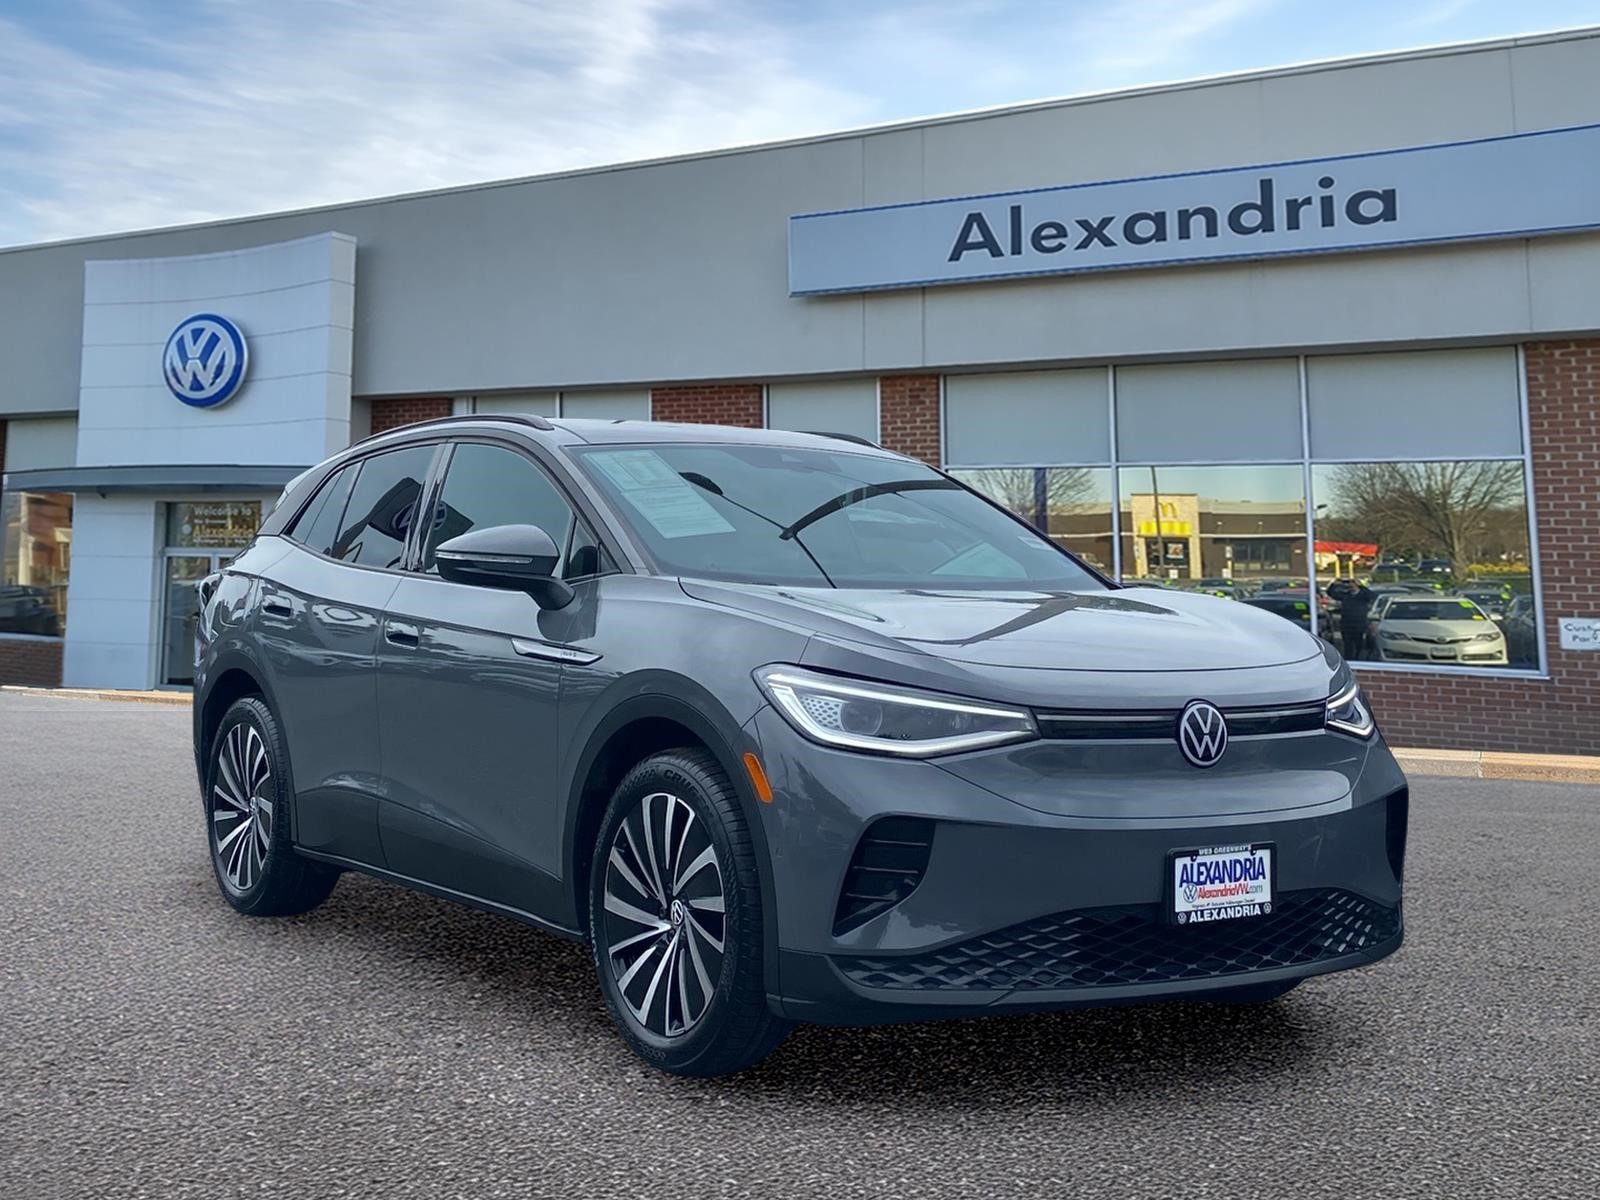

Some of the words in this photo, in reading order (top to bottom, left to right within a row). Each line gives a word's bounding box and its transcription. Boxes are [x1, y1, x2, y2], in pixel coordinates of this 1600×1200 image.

[947, 176, 1397, 262] Alexandria
[1179, 856, 1267, 888] ALEXANDRIA
[1188, 903, 1262, 924] ALEXANDRIA
